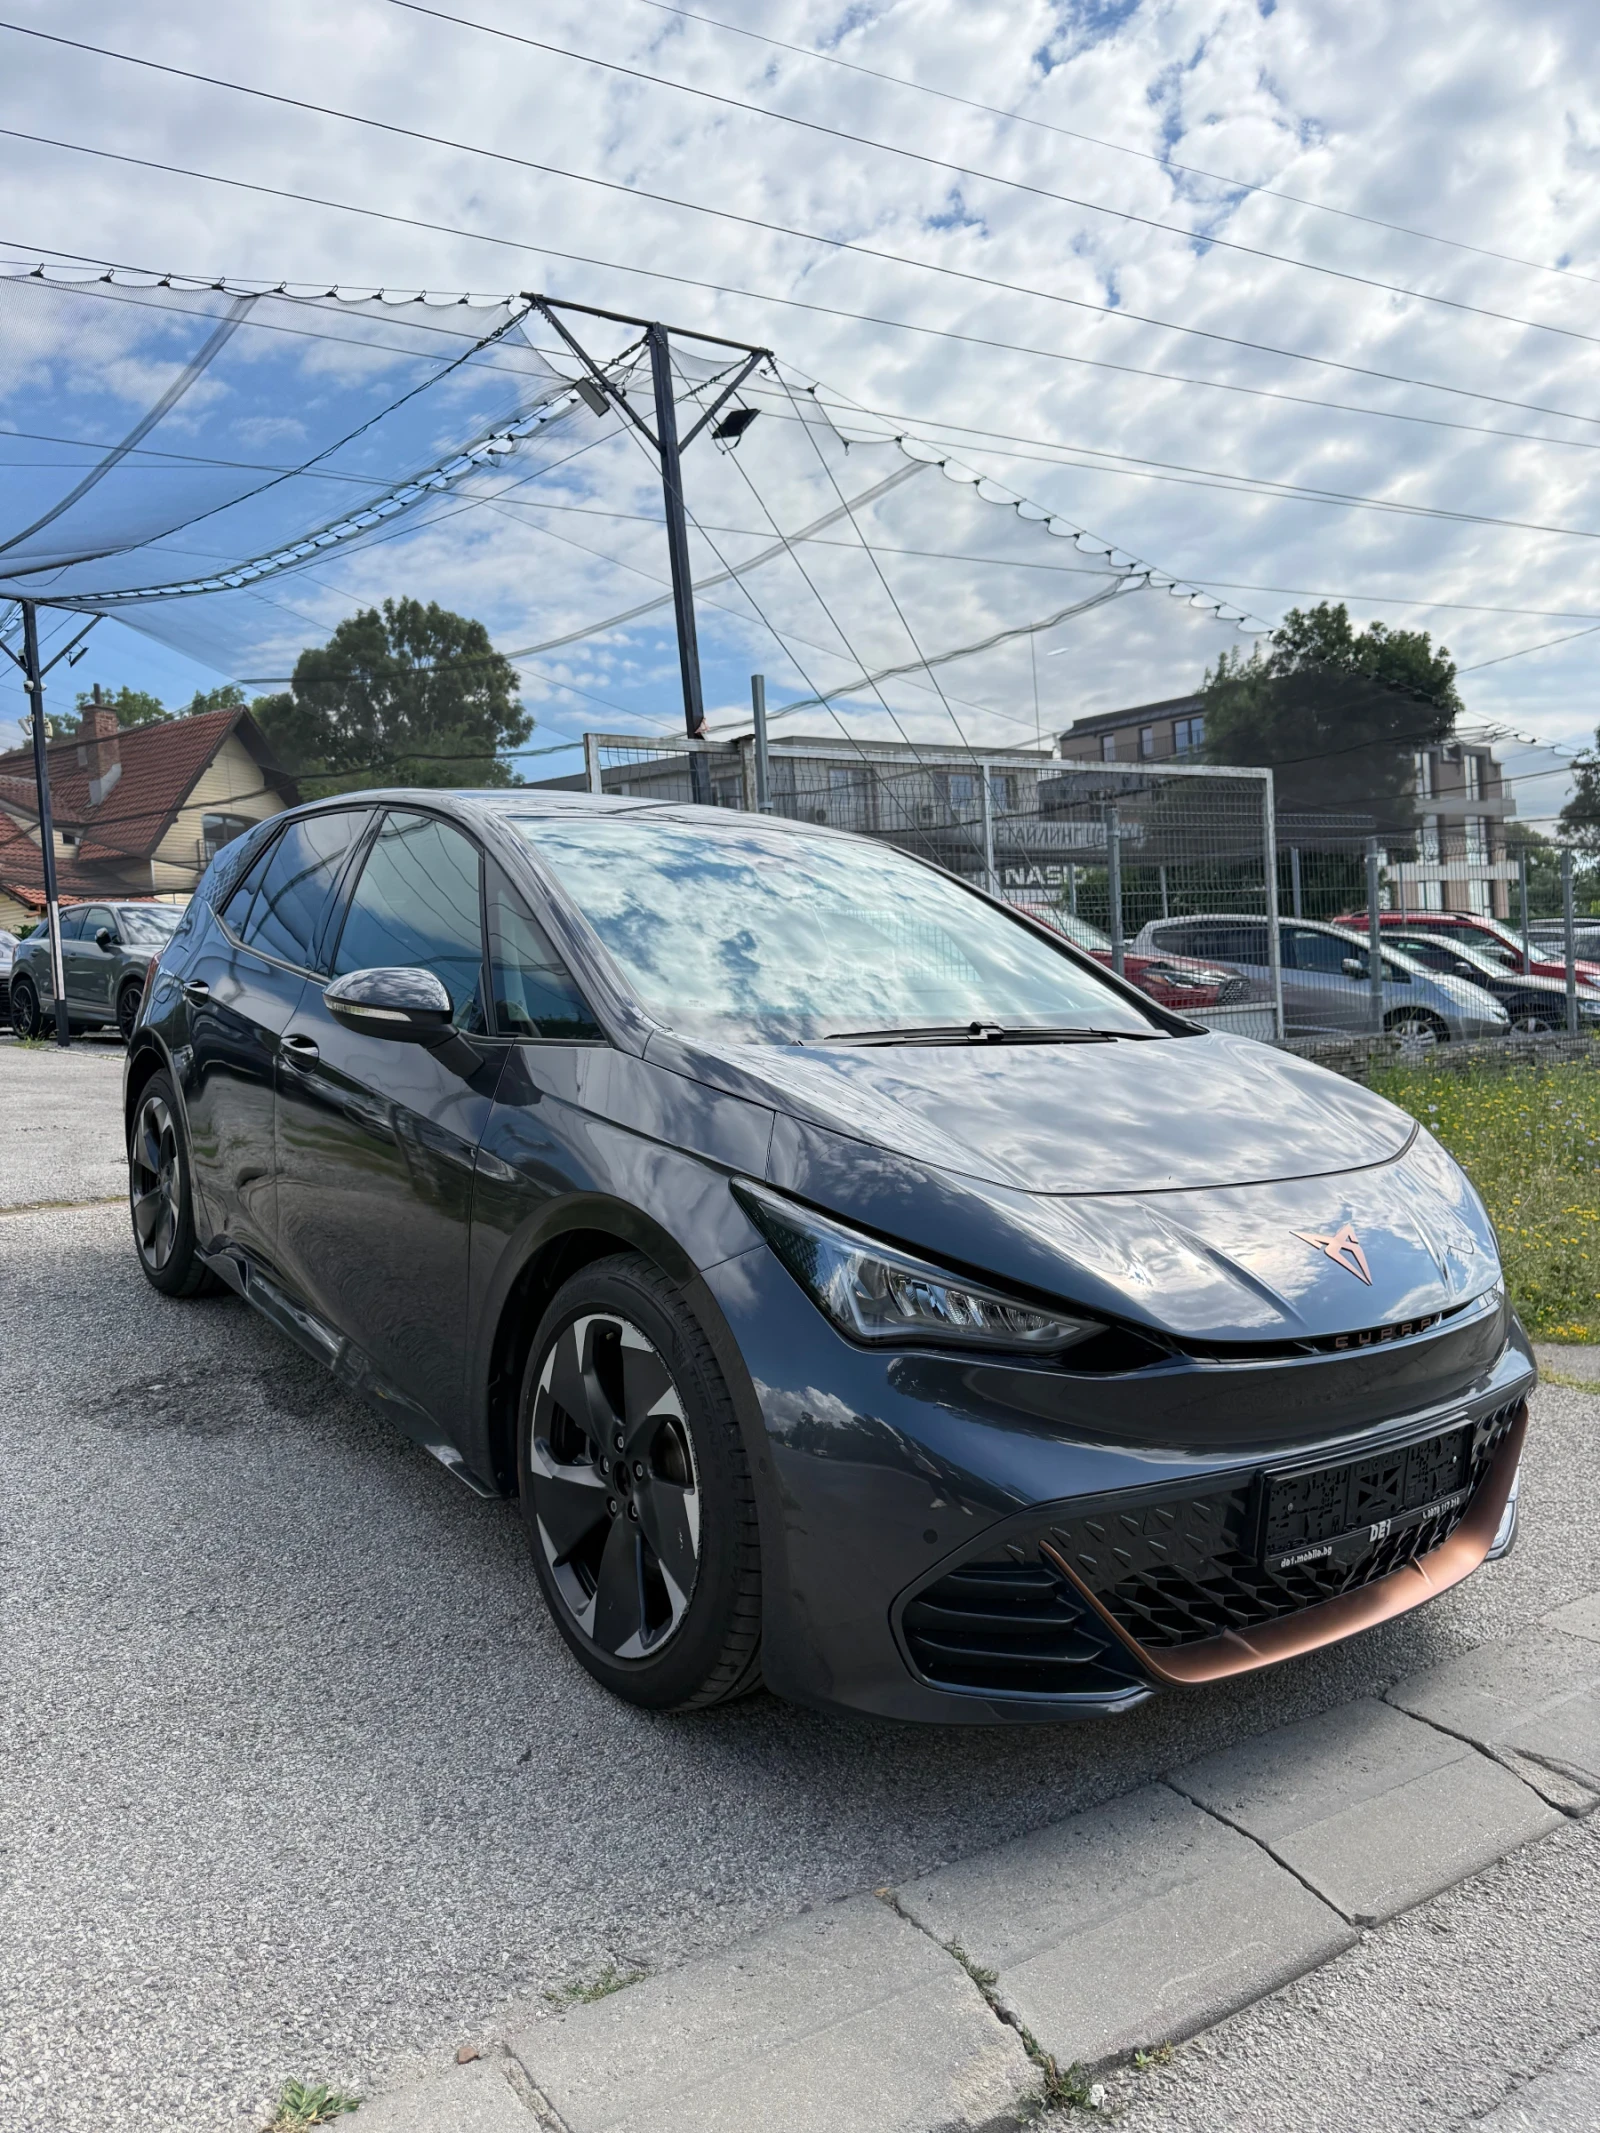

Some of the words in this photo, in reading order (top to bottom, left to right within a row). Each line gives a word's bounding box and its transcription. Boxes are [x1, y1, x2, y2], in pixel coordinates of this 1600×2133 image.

[993, 824, 1082, 844] ЕТАЙЛИНГ
[1335, 1317, 1431, 1347] CUPRA
[1369, 1519, 1391, 1542] DE1
